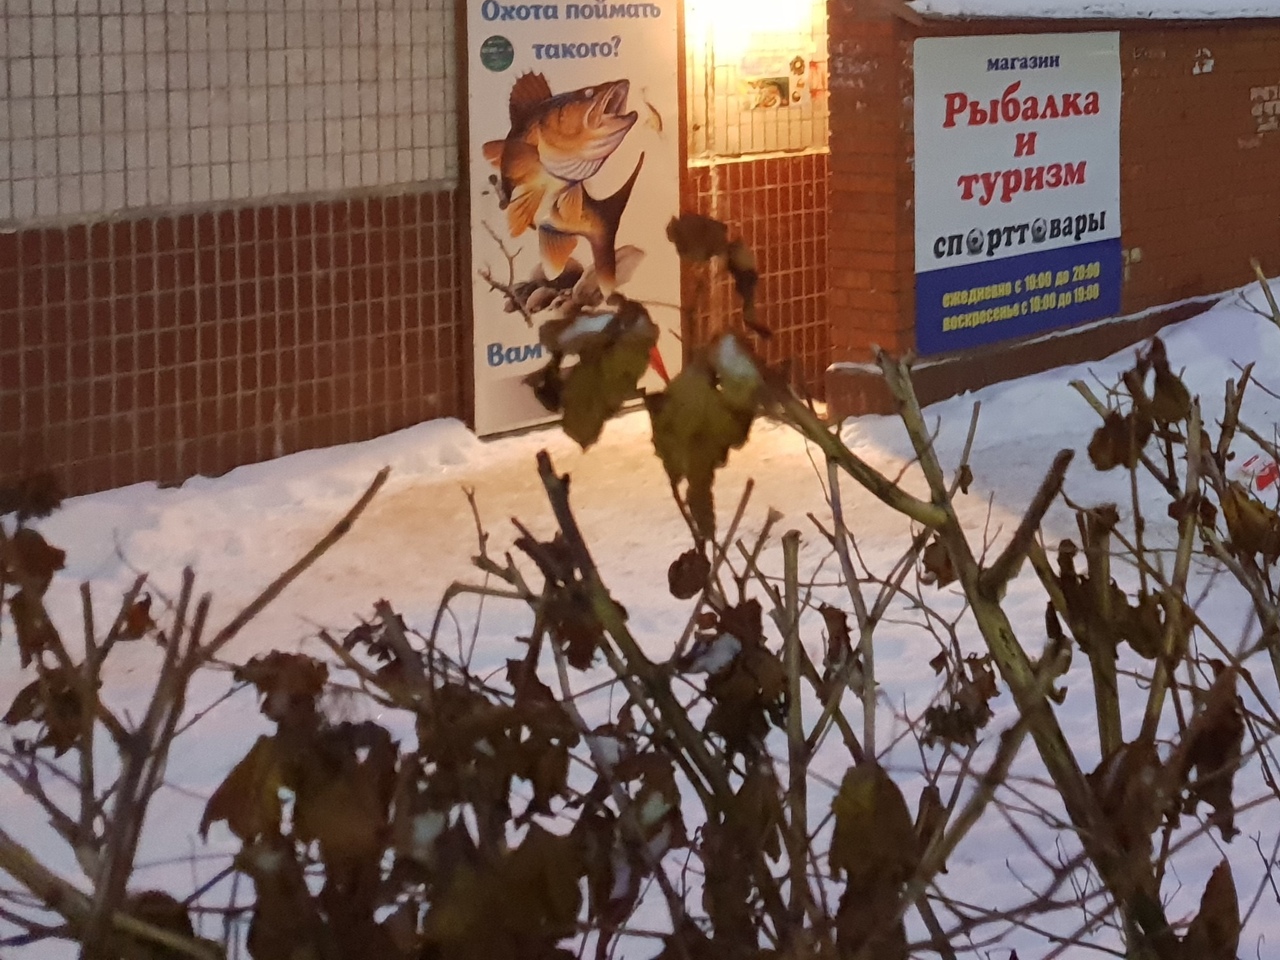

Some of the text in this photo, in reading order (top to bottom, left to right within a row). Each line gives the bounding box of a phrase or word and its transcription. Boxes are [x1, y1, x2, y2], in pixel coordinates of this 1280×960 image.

[481, 0, 558, 21] Охота
[532, 35, 621, 59] такого?
[986, 55, 1060, 71] магазин
[942, 80, 1100, 128] Рыбалка
[1014, 131, 1037, 157] и
[957, 161, 1087, 206] туризм
[933, 210, 1106, 258] спорттовары
[942, 281, 1012, 308] ежедневно
[1014, 279, 1023, 294] с
[1054, 269, 1070, 288] до
[1071, 261, 1100, 282] 20:00
[942, 302, 1020, 333] воскресенье
[1021, 300, 1028, 315] с
[1057, 291, 1072, 310] до
[487, 343, 542, 366] Вам
